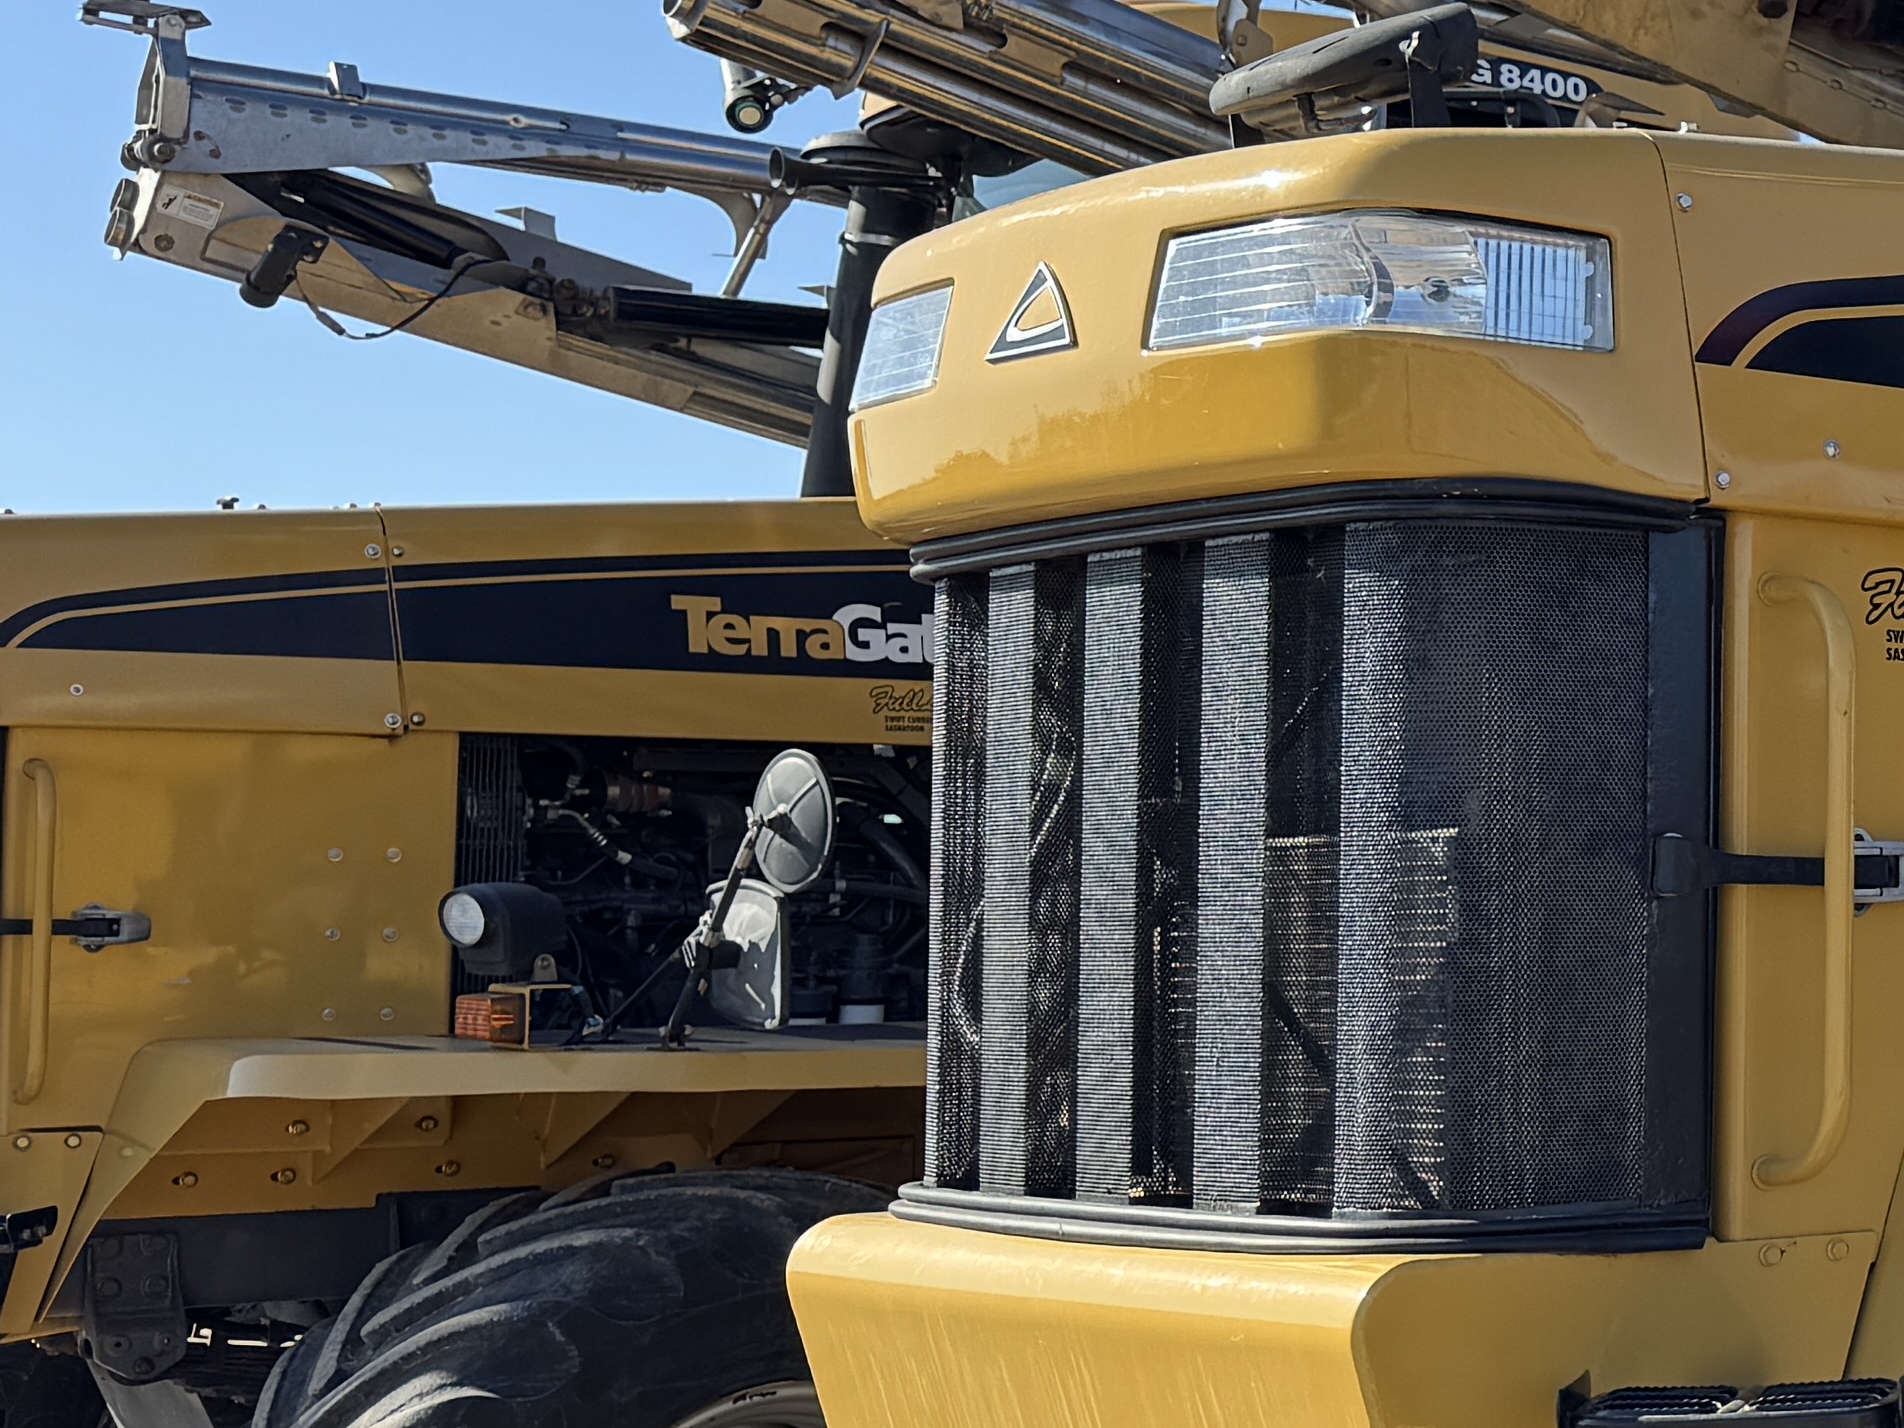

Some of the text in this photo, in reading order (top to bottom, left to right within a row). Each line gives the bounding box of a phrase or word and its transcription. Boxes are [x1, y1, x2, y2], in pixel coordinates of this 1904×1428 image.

[1499, 63, 1588, 102] 8400
[671, 594, 934, 664] TerraGat
[869, 684, 925, 715] Full
